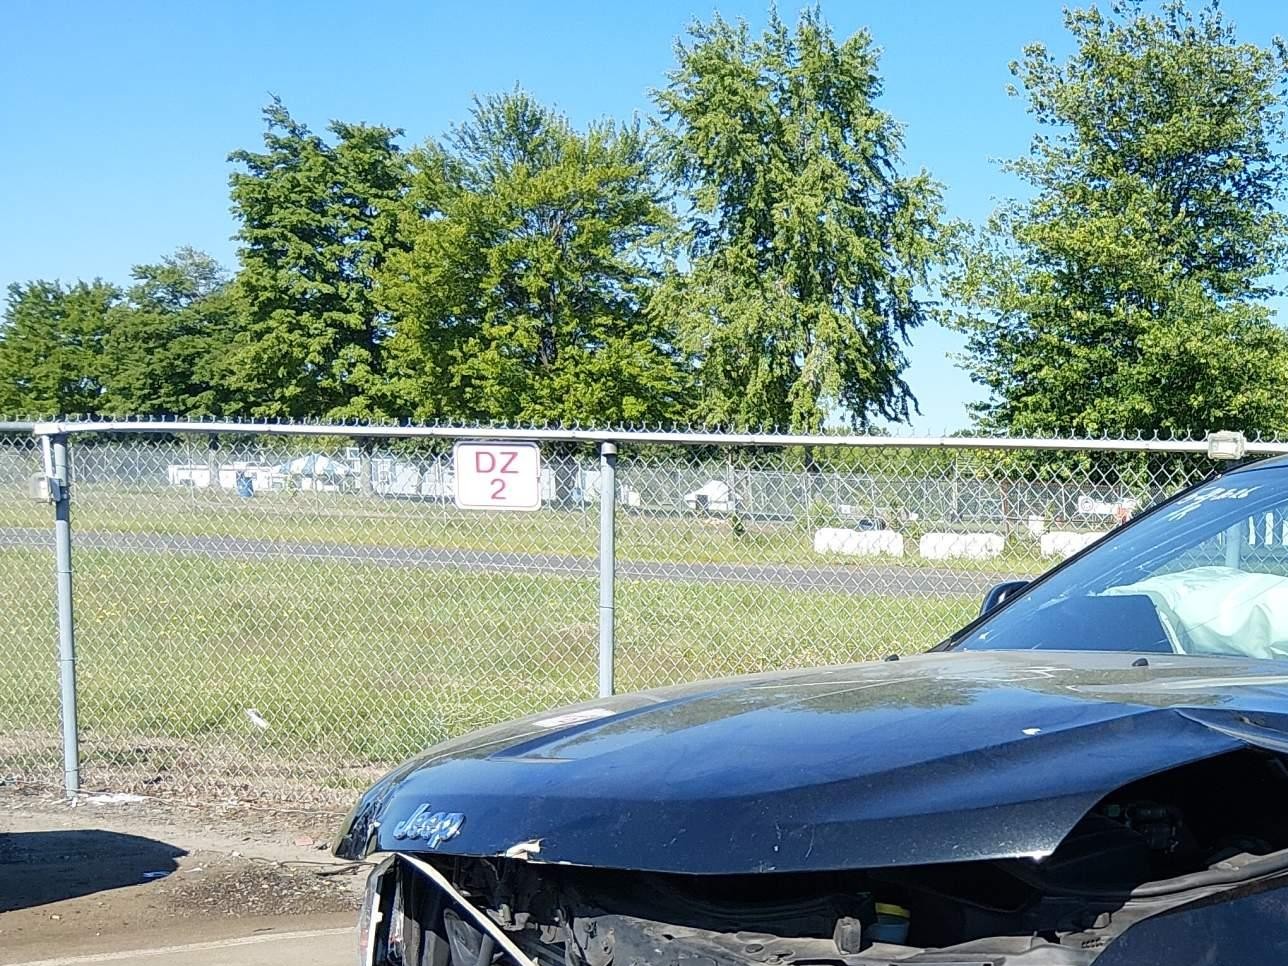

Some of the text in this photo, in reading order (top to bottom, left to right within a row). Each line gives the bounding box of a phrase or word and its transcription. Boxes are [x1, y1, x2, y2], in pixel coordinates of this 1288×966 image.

[475, 451, 519, 474] DZ
[490, 478, 507, 500] 2
[393, 803, 465, 850] Jeep
